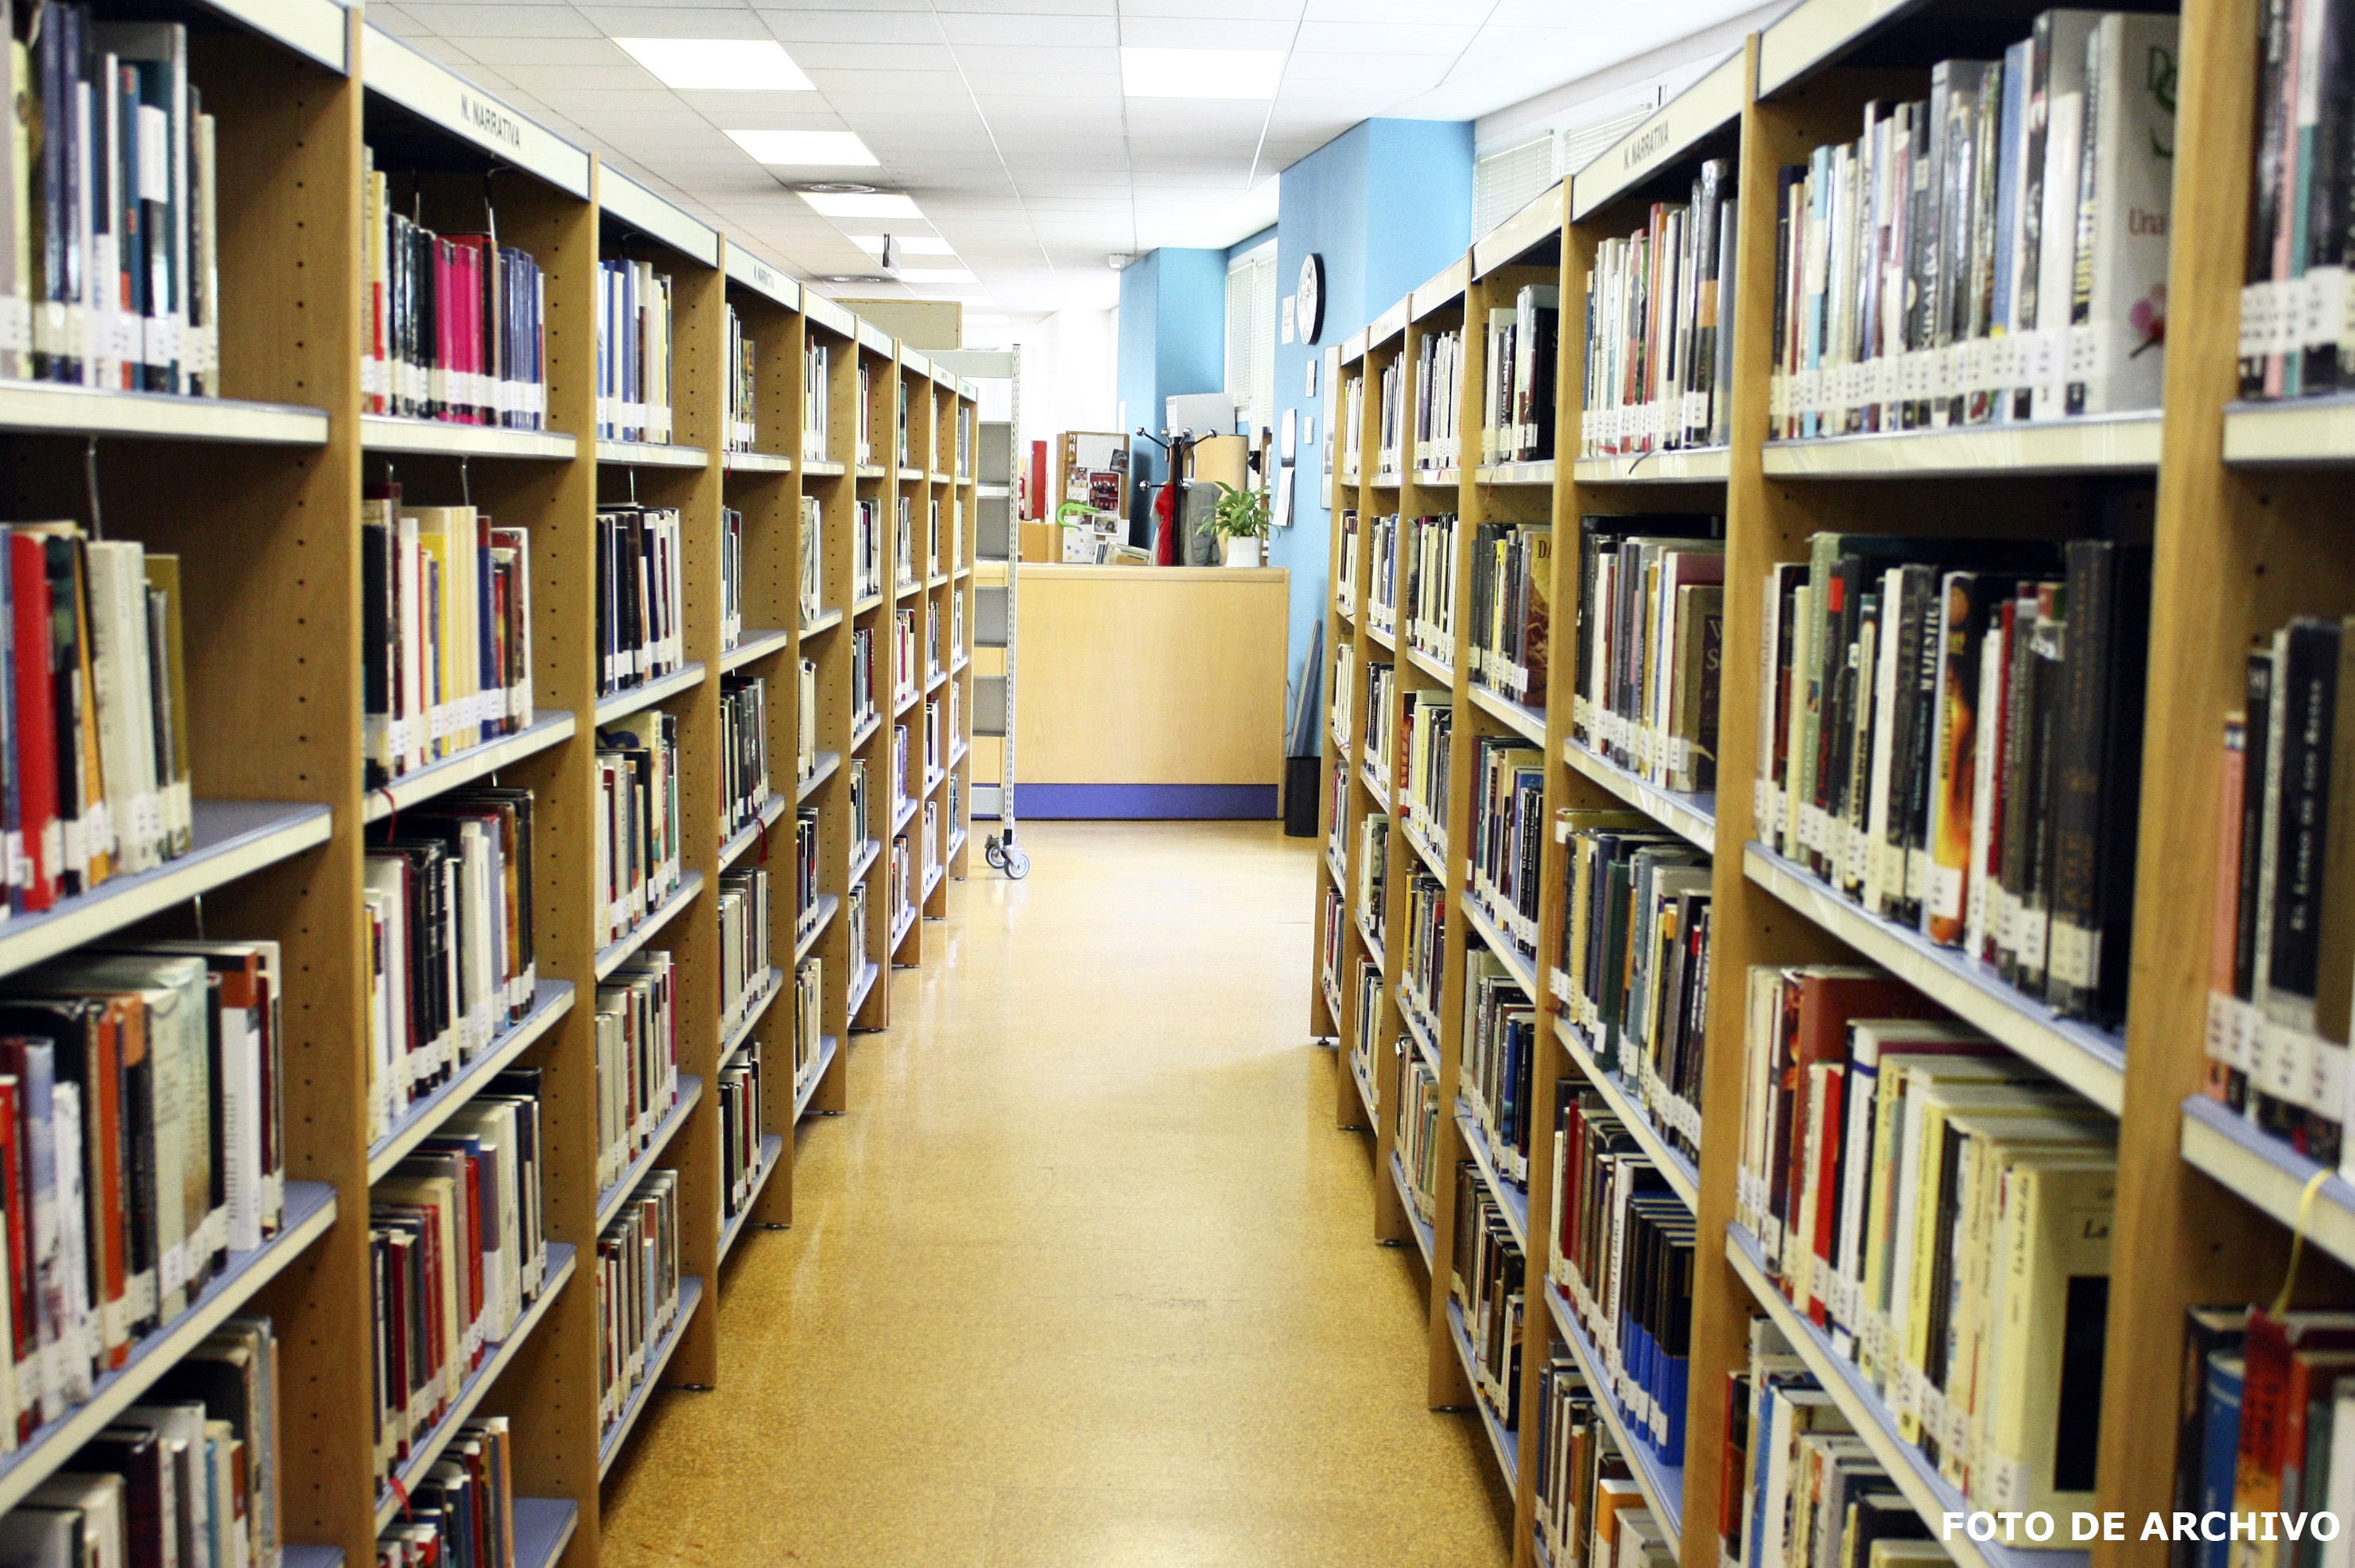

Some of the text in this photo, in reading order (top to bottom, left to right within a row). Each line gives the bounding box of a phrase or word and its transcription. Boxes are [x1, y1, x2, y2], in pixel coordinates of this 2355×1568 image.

[460, 94, 521, 149] N. NARRATIVA
[1631, 119, 1669, 166] NARRATIVA
[2128, 206, 2167, 236] Una
